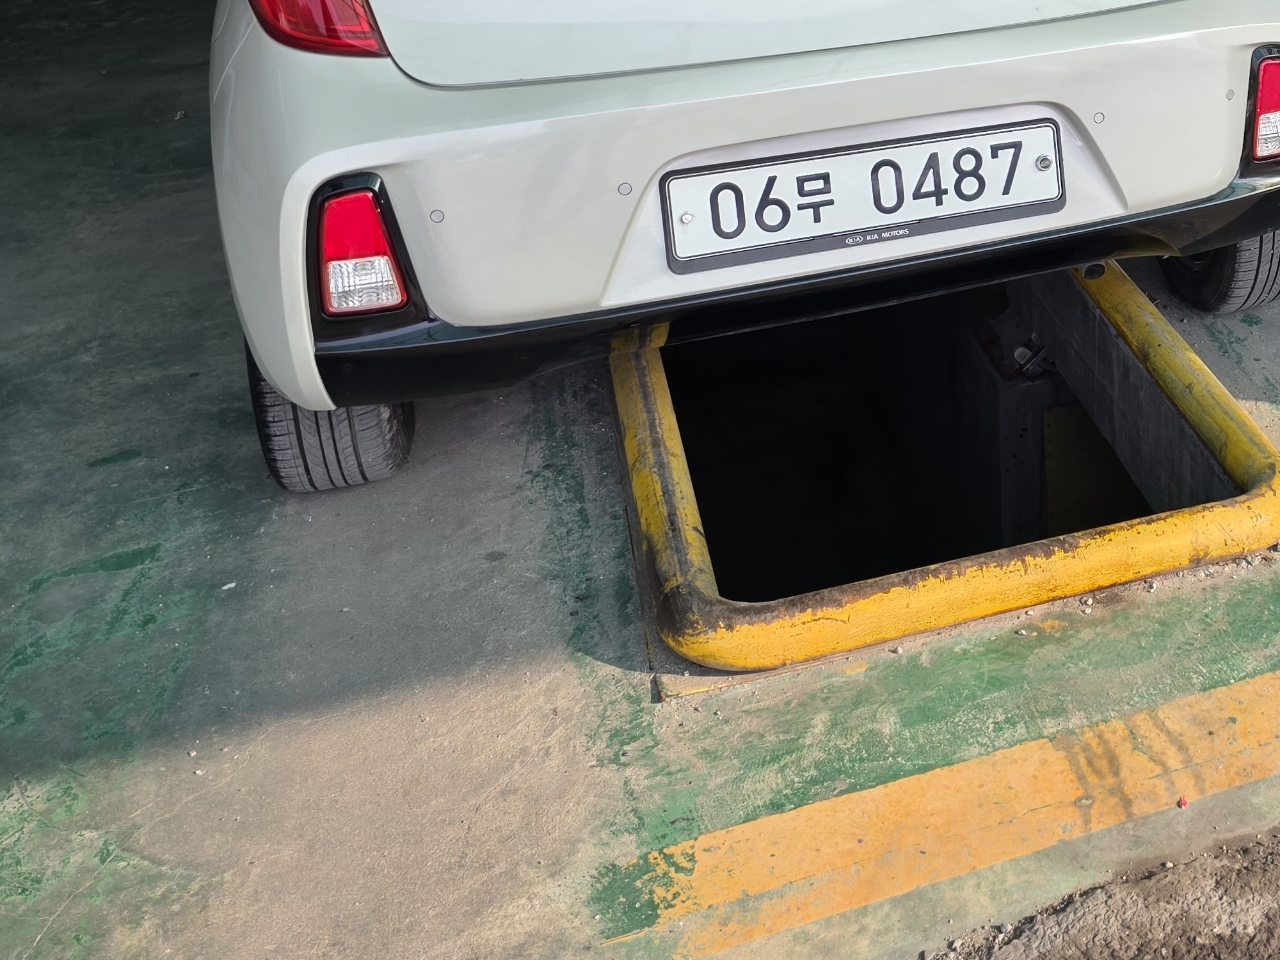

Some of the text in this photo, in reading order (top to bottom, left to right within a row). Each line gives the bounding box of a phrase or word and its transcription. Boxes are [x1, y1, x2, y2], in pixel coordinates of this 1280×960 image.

[709, 140, 1024, 240] 06무 0487
[882, 228, 910, 239] MOTORS
